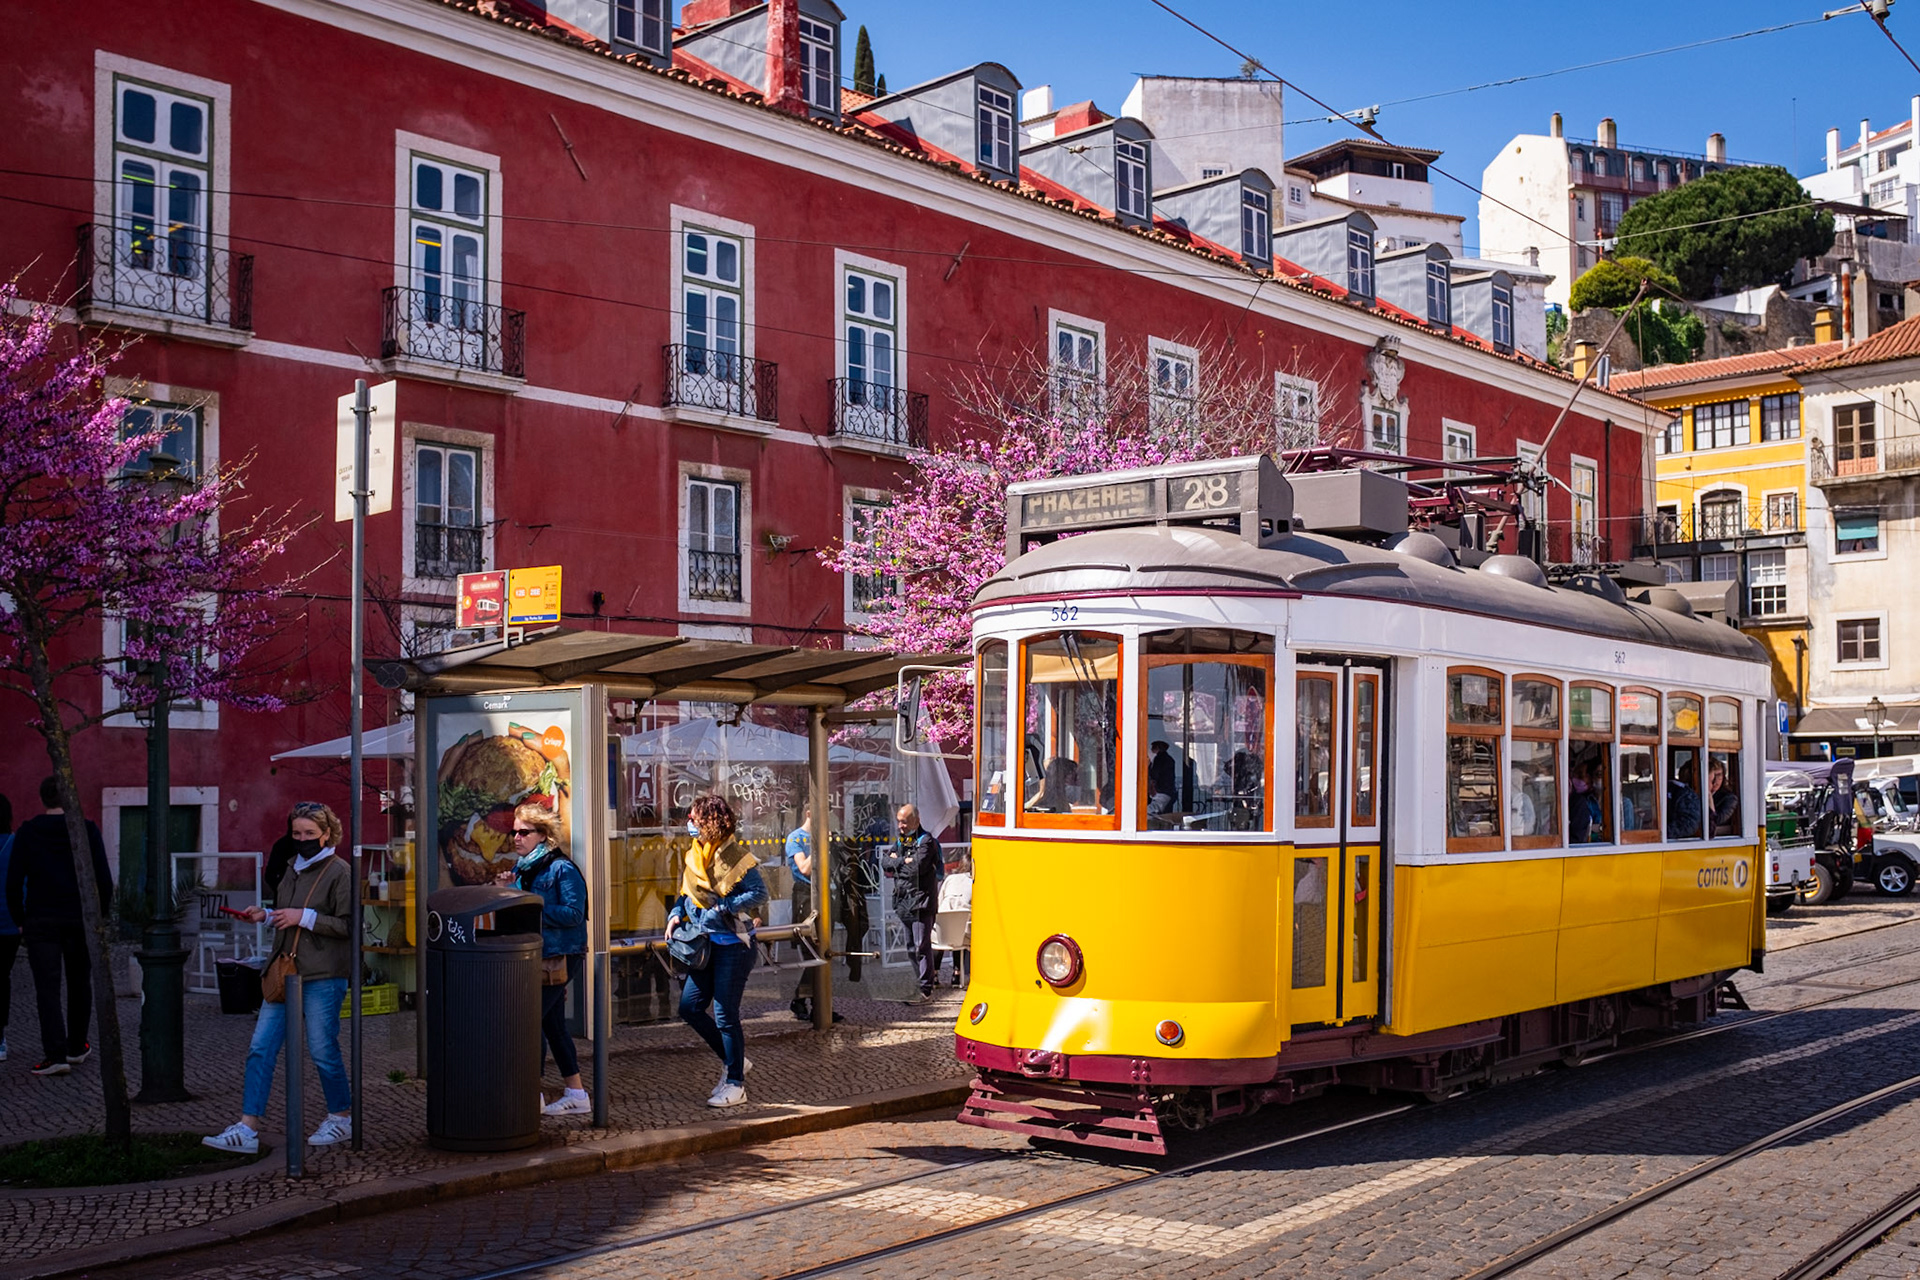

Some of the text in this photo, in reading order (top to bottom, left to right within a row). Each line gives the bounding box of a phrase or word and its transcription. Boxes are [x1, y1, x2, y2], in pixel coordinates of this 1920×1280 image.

[1028, 486, 1146, 514] PRAZERES
[1184, 475, 1229, 511] 28
[1051, 606, 1079, 622] 562
[1614, 651, 1626, 664] 562
[483, 701, 509, 710] Cemark
[1780, 705, 1787, 730] P
[543, 737, 563, 748] Crispy
[1697, 859, 1729, 889] carris
[200, 894, 231, 919] PIZZA
